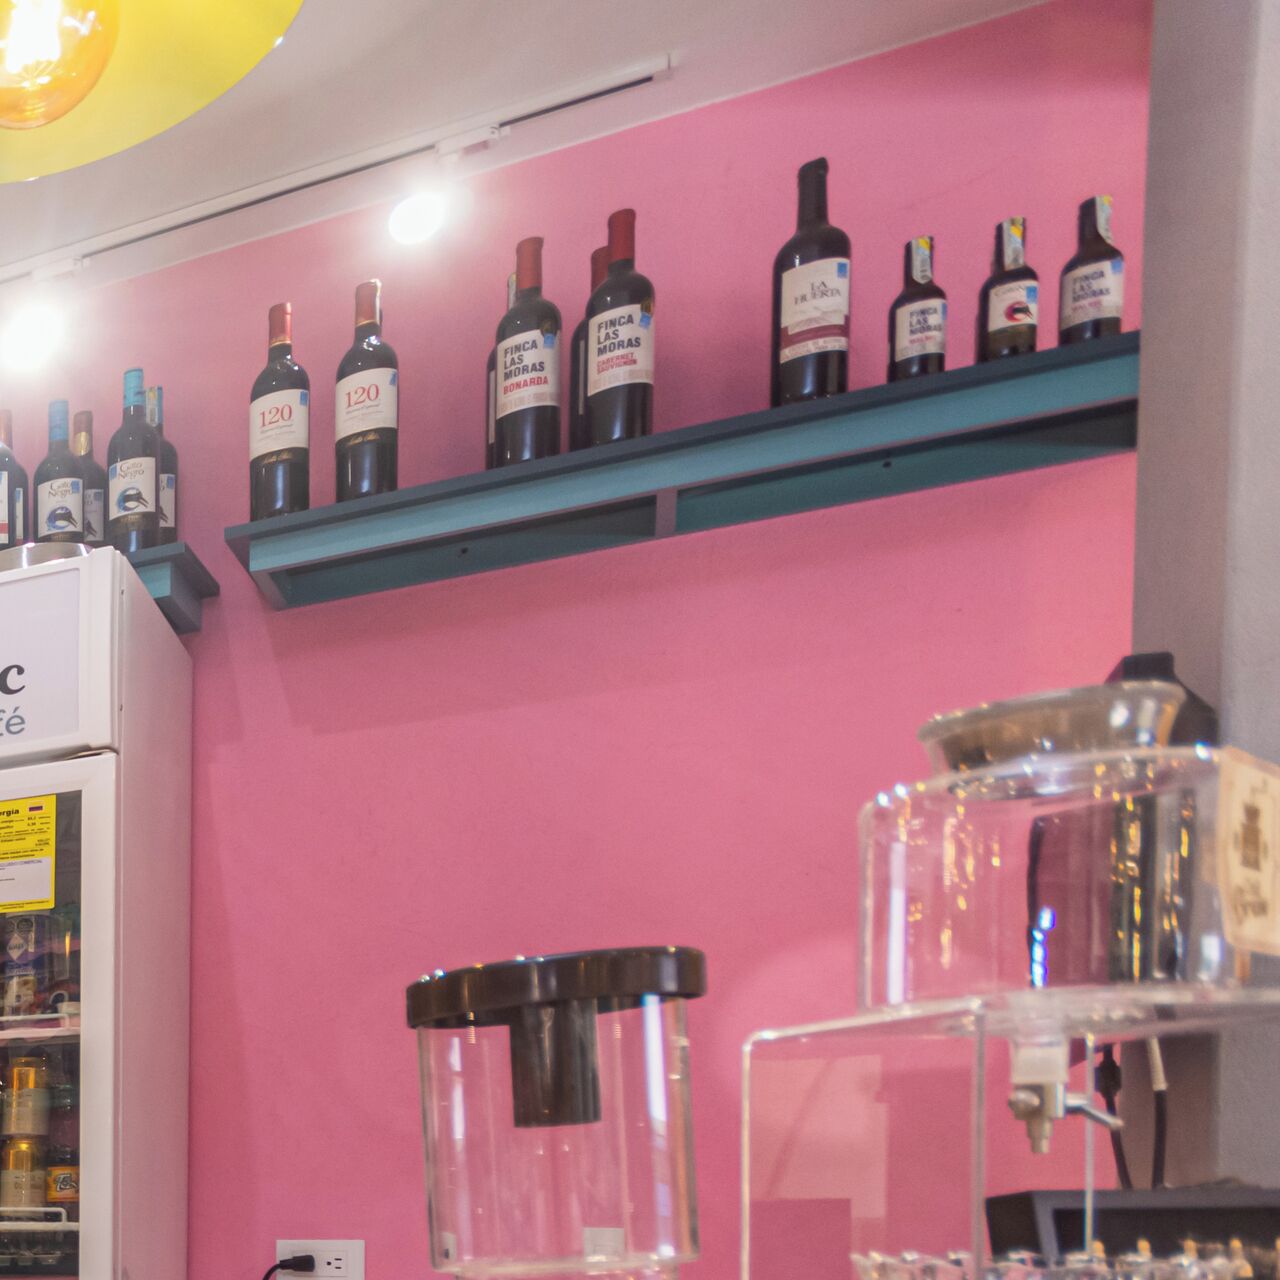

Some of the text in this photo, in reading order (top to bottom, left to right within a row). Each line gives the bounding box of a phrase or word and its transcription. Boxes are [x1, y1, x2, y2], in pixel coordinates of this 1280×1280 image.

[597, 314, 634, 333] FINCA
[597, 329, 619, 346] LAS
[597, 337, 641, 357] MORAS
[504, 339, 538, 358] FINCA
[504, 354, 524, 370] LAS
[503, 362, 545, 382] MORAS
[503, 376, 549, 395] BONARDA
[346, 383, 380, 409] 120
[259, 404, 293, 428] 120
